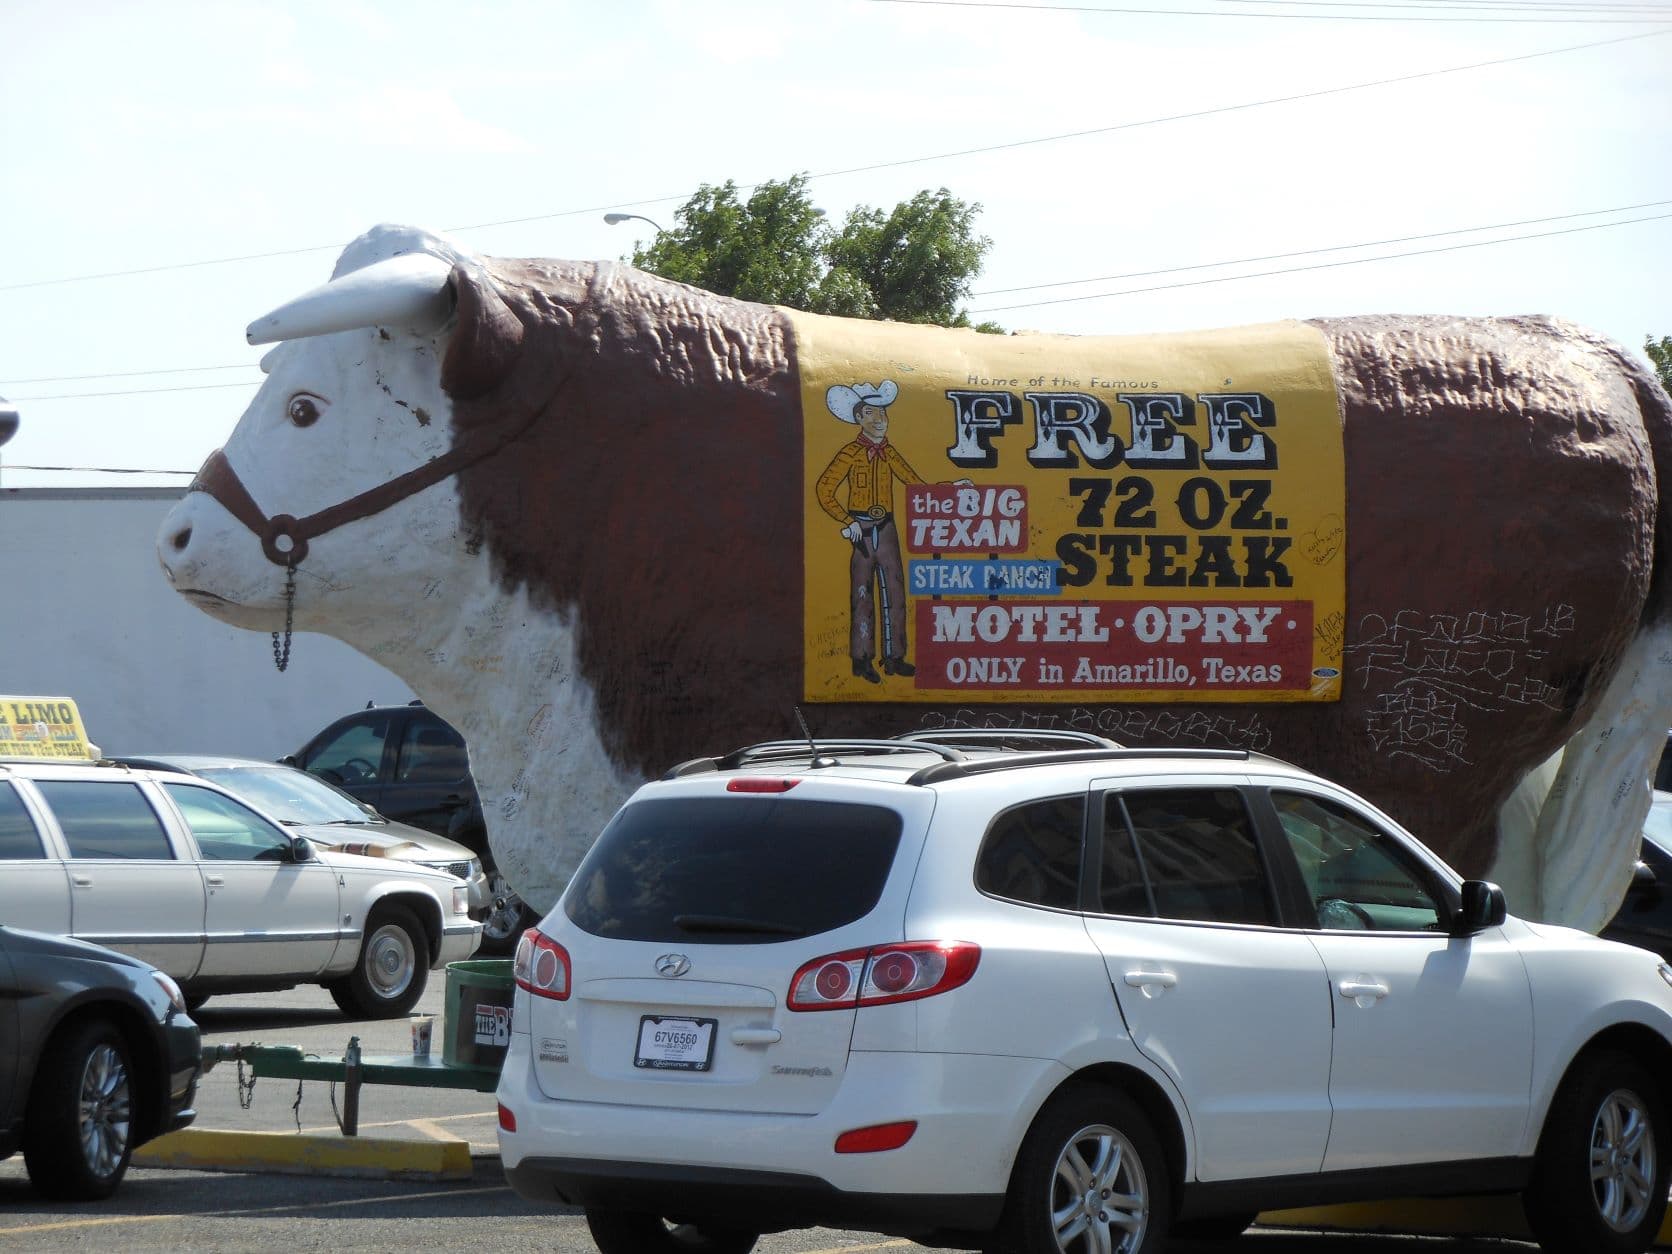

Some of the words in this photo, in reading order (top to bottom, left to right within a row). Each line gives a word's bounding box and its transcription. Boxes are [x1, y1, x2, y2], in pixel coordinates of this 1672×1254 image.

[967, 375, 1018, 387] Home
[1029, 376, 1046, 387] of
[1052, 377, 1081, 388] the
[1090, 377, 1160, 389] Famous
[945, 390, 1279, 470] FREE
[912, 492, 954, 514] the
[956, 488, 1026, 517] BIG
[1069, 476, 1157, 528] 72
[1174, 476, 1289, 530] OZ.
[911, 518, 1022, 547] TEXAN
[1056, 533, 1294, 587] STEAK
[914, 565, 974, 589] STEAK
[932, 605, 1110, 643] MOTEL
[1132, 605, 1282, 643] OPRY
[946, 656, 1026, 683] ONLY
[1038, 657, 1064, 683] in
[1072, 656, 1197, 686] Amarillo,
[1202, 658, 1282, 683] Texas
[10, 703, 74, 724] LIMO
[475, 1014, 496, 1036] THE
[654, 1031, 698, 1045] 67V6560
